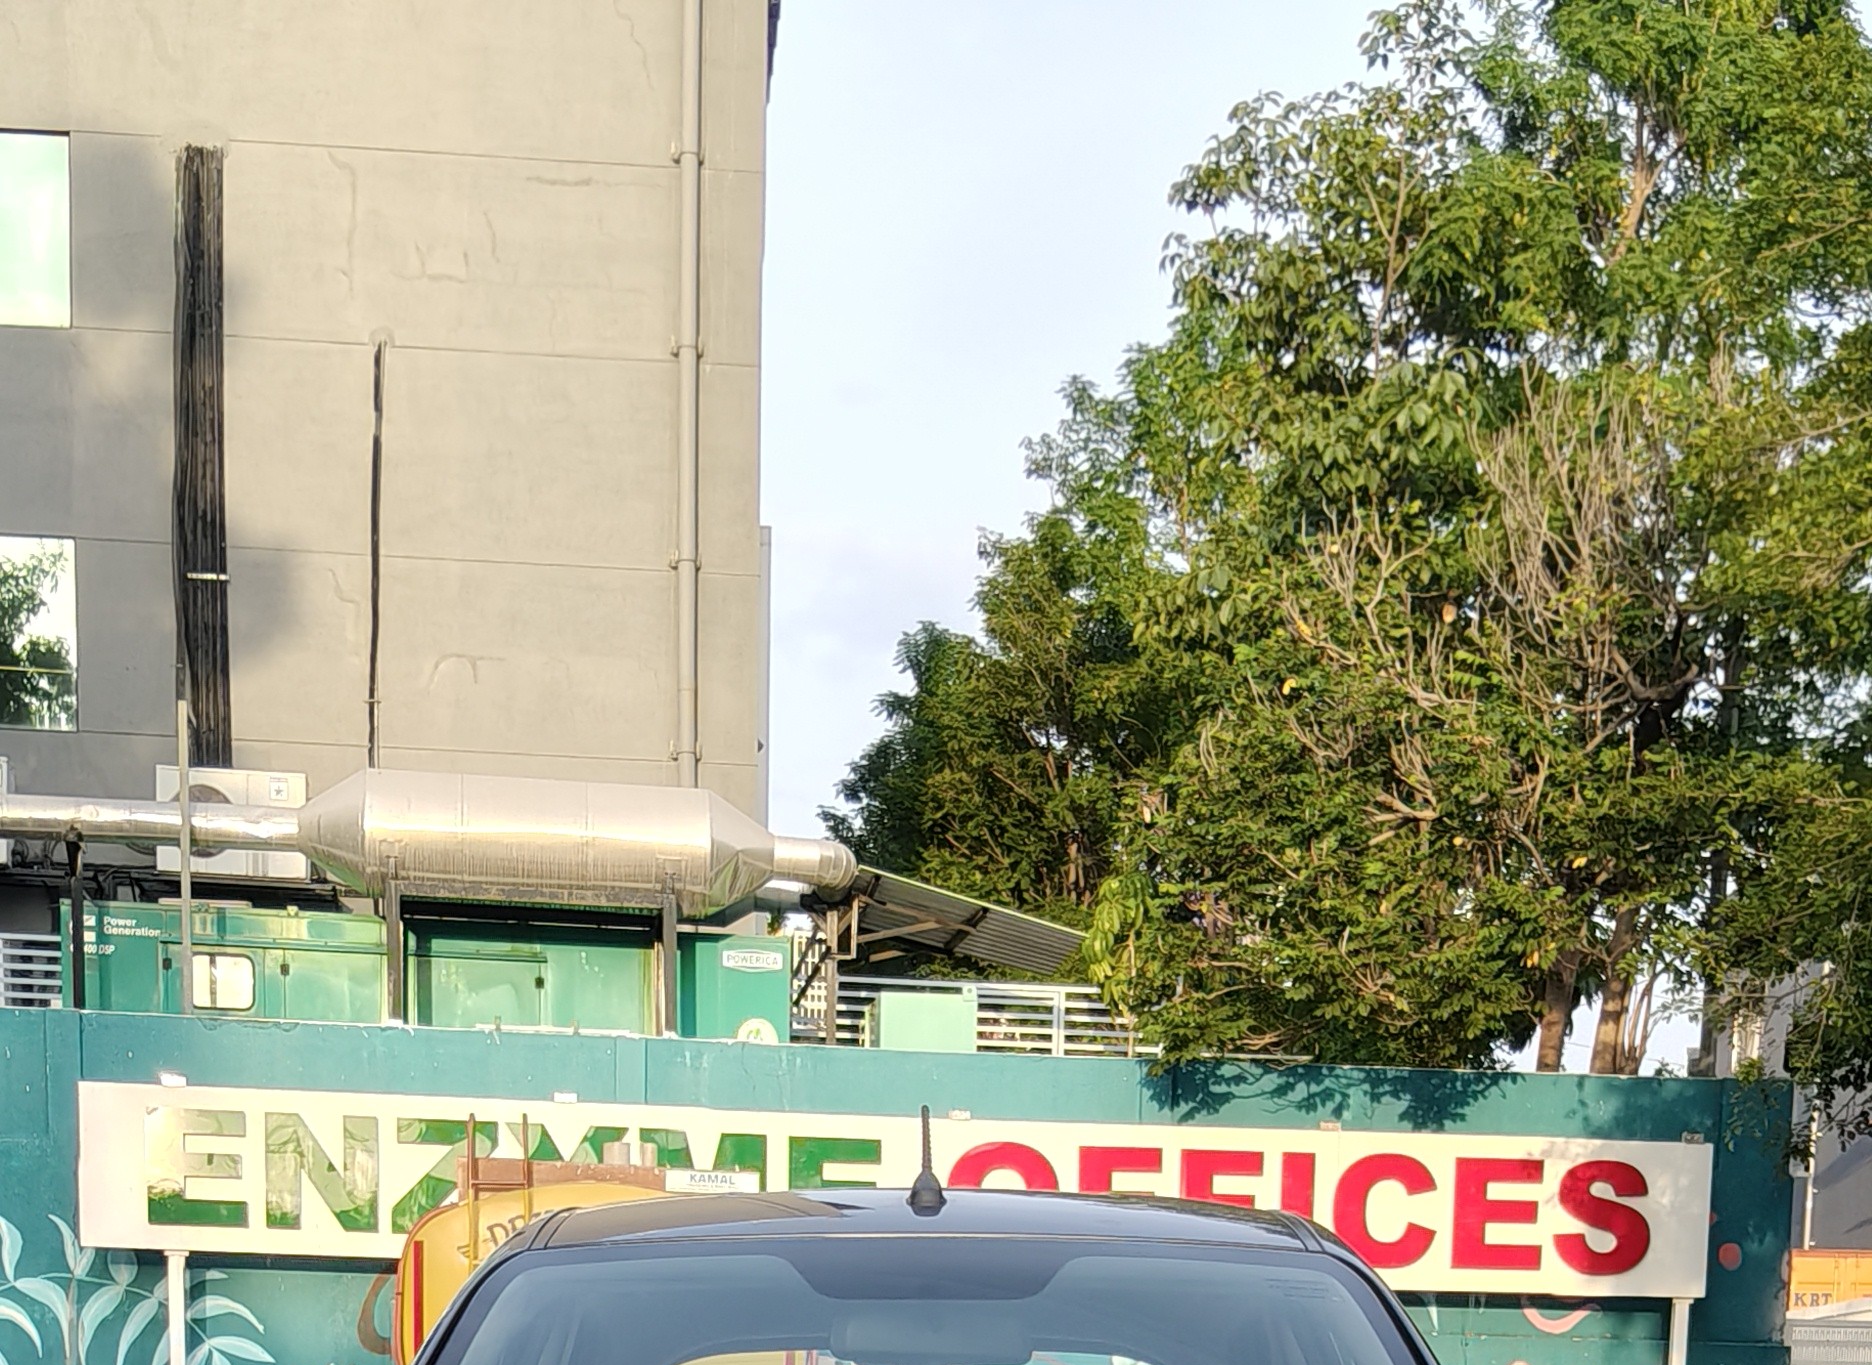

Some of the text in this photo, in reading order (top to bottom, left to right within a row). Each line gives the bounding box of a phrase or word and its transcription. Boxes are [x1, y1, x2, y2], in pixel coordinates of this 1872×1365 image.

[103, 915, 138, 927] Power
[103, 925, 161, 937] Generation
[727, 954, 778, 966] POWERICA
[690, 1173, 736, 1185] KAMAL
[1793, 1292, 1833, 1308] KRT
